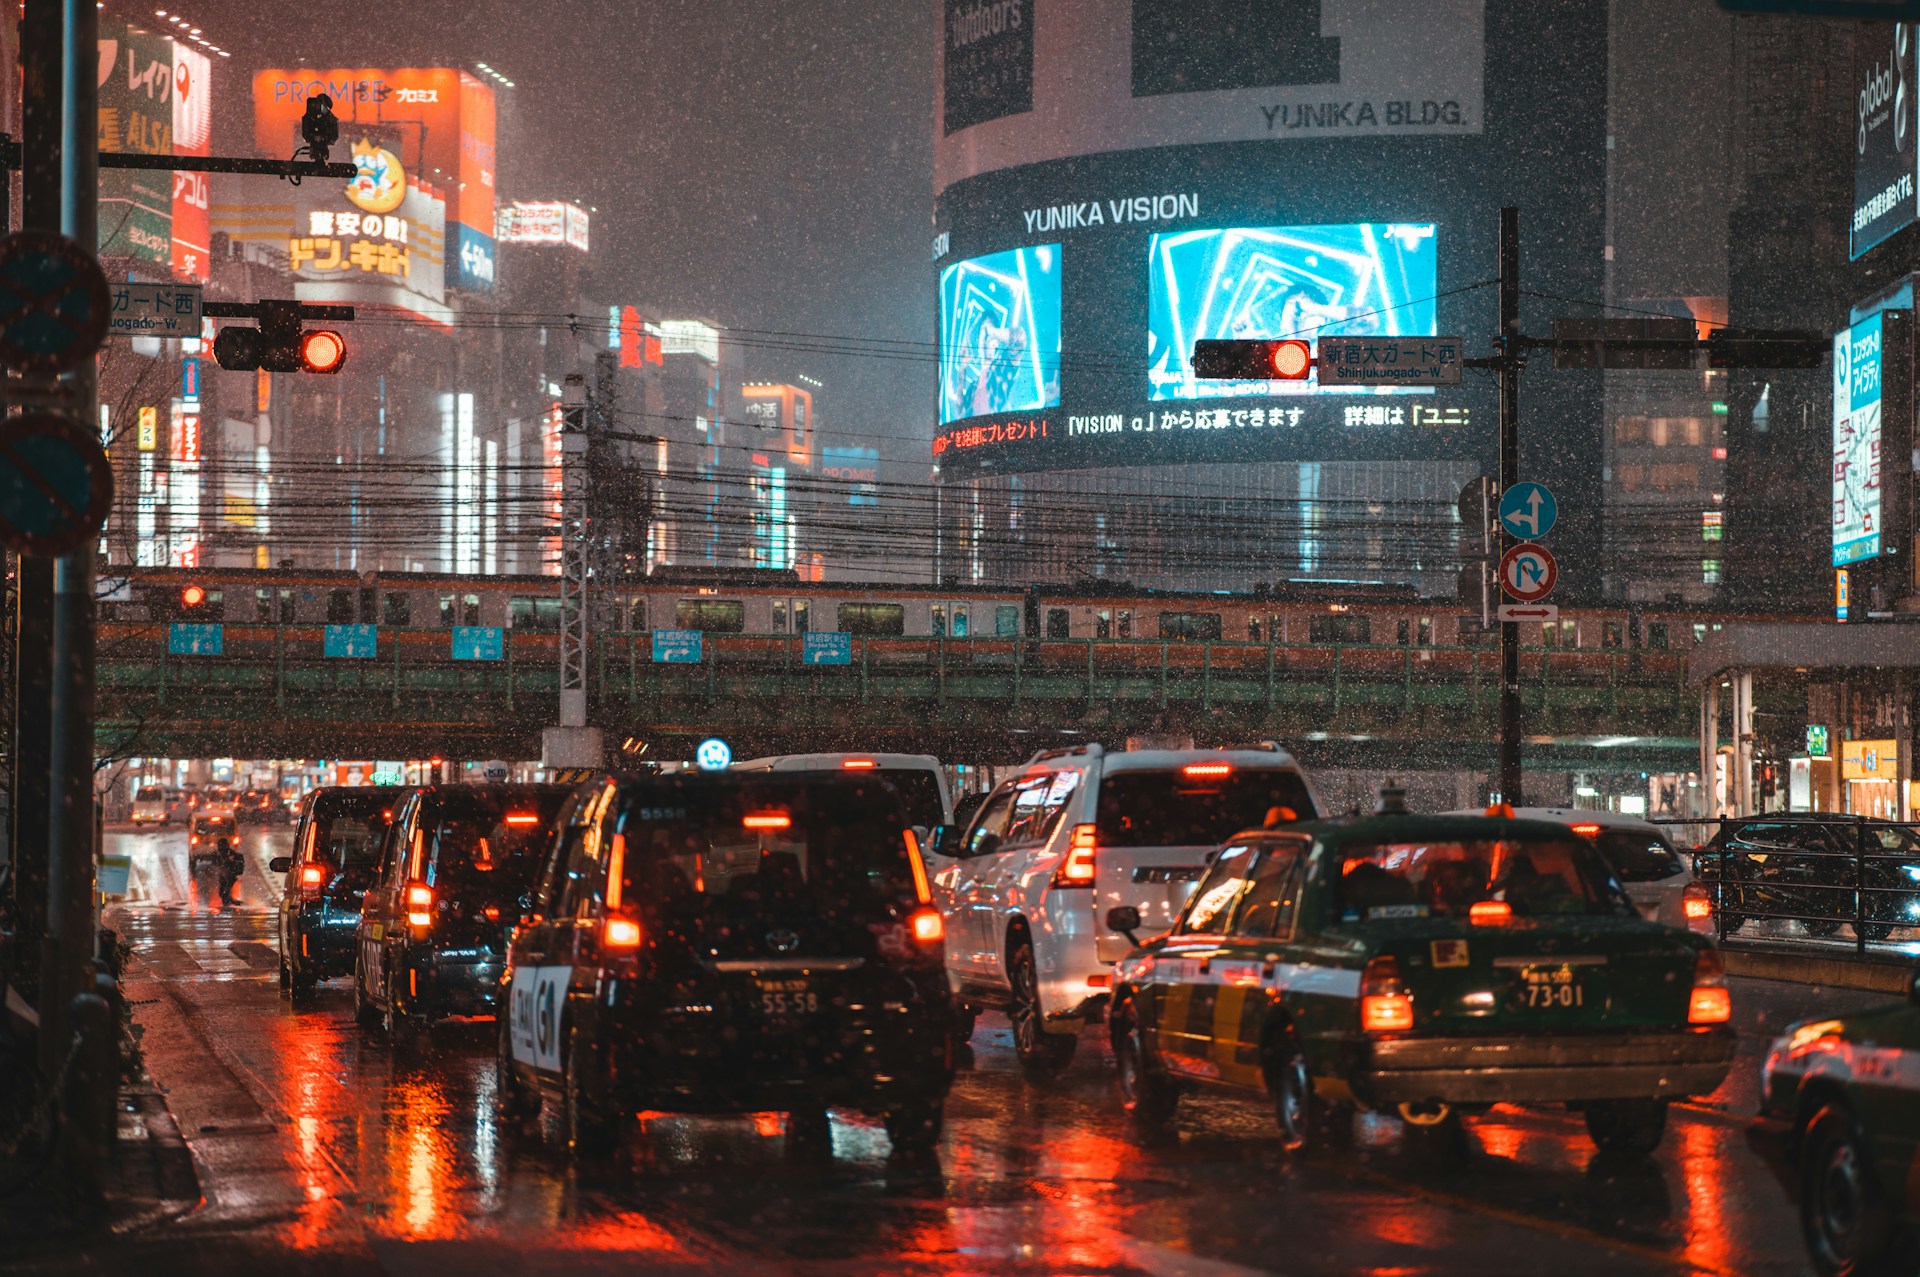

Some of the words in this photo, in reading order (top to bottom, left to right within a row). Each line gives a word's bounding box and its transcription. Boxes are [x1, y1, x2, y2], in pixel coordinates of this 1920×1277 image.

[129, 48, 171, 104] レイク
[275, 80, 384, 103] PROMISE
[396, 88, 439, 103] プロミス
[1859, 49, 1893, 154] global
[1261, 101, 1378, 130] YUNIKA
[1386, 100, 1468, 126] BLDG.
[126, 111, 172, 155] ALSA
[1024, 202, 1104, 234] YUNIKA
[1109, 193, 1199, 224] VISION
[112, 290, 194, 314] ガード西
[1325, 343, 1456, 364] 新宿大ガード西
[1852, 330, 1880, 363] コンタクトの
[1337, 367, 1445, 379] Shinjukuogado-W.
[762, 993, 817, 1014] 55-58
[1527, 985, 1583, 1008] 73-01
